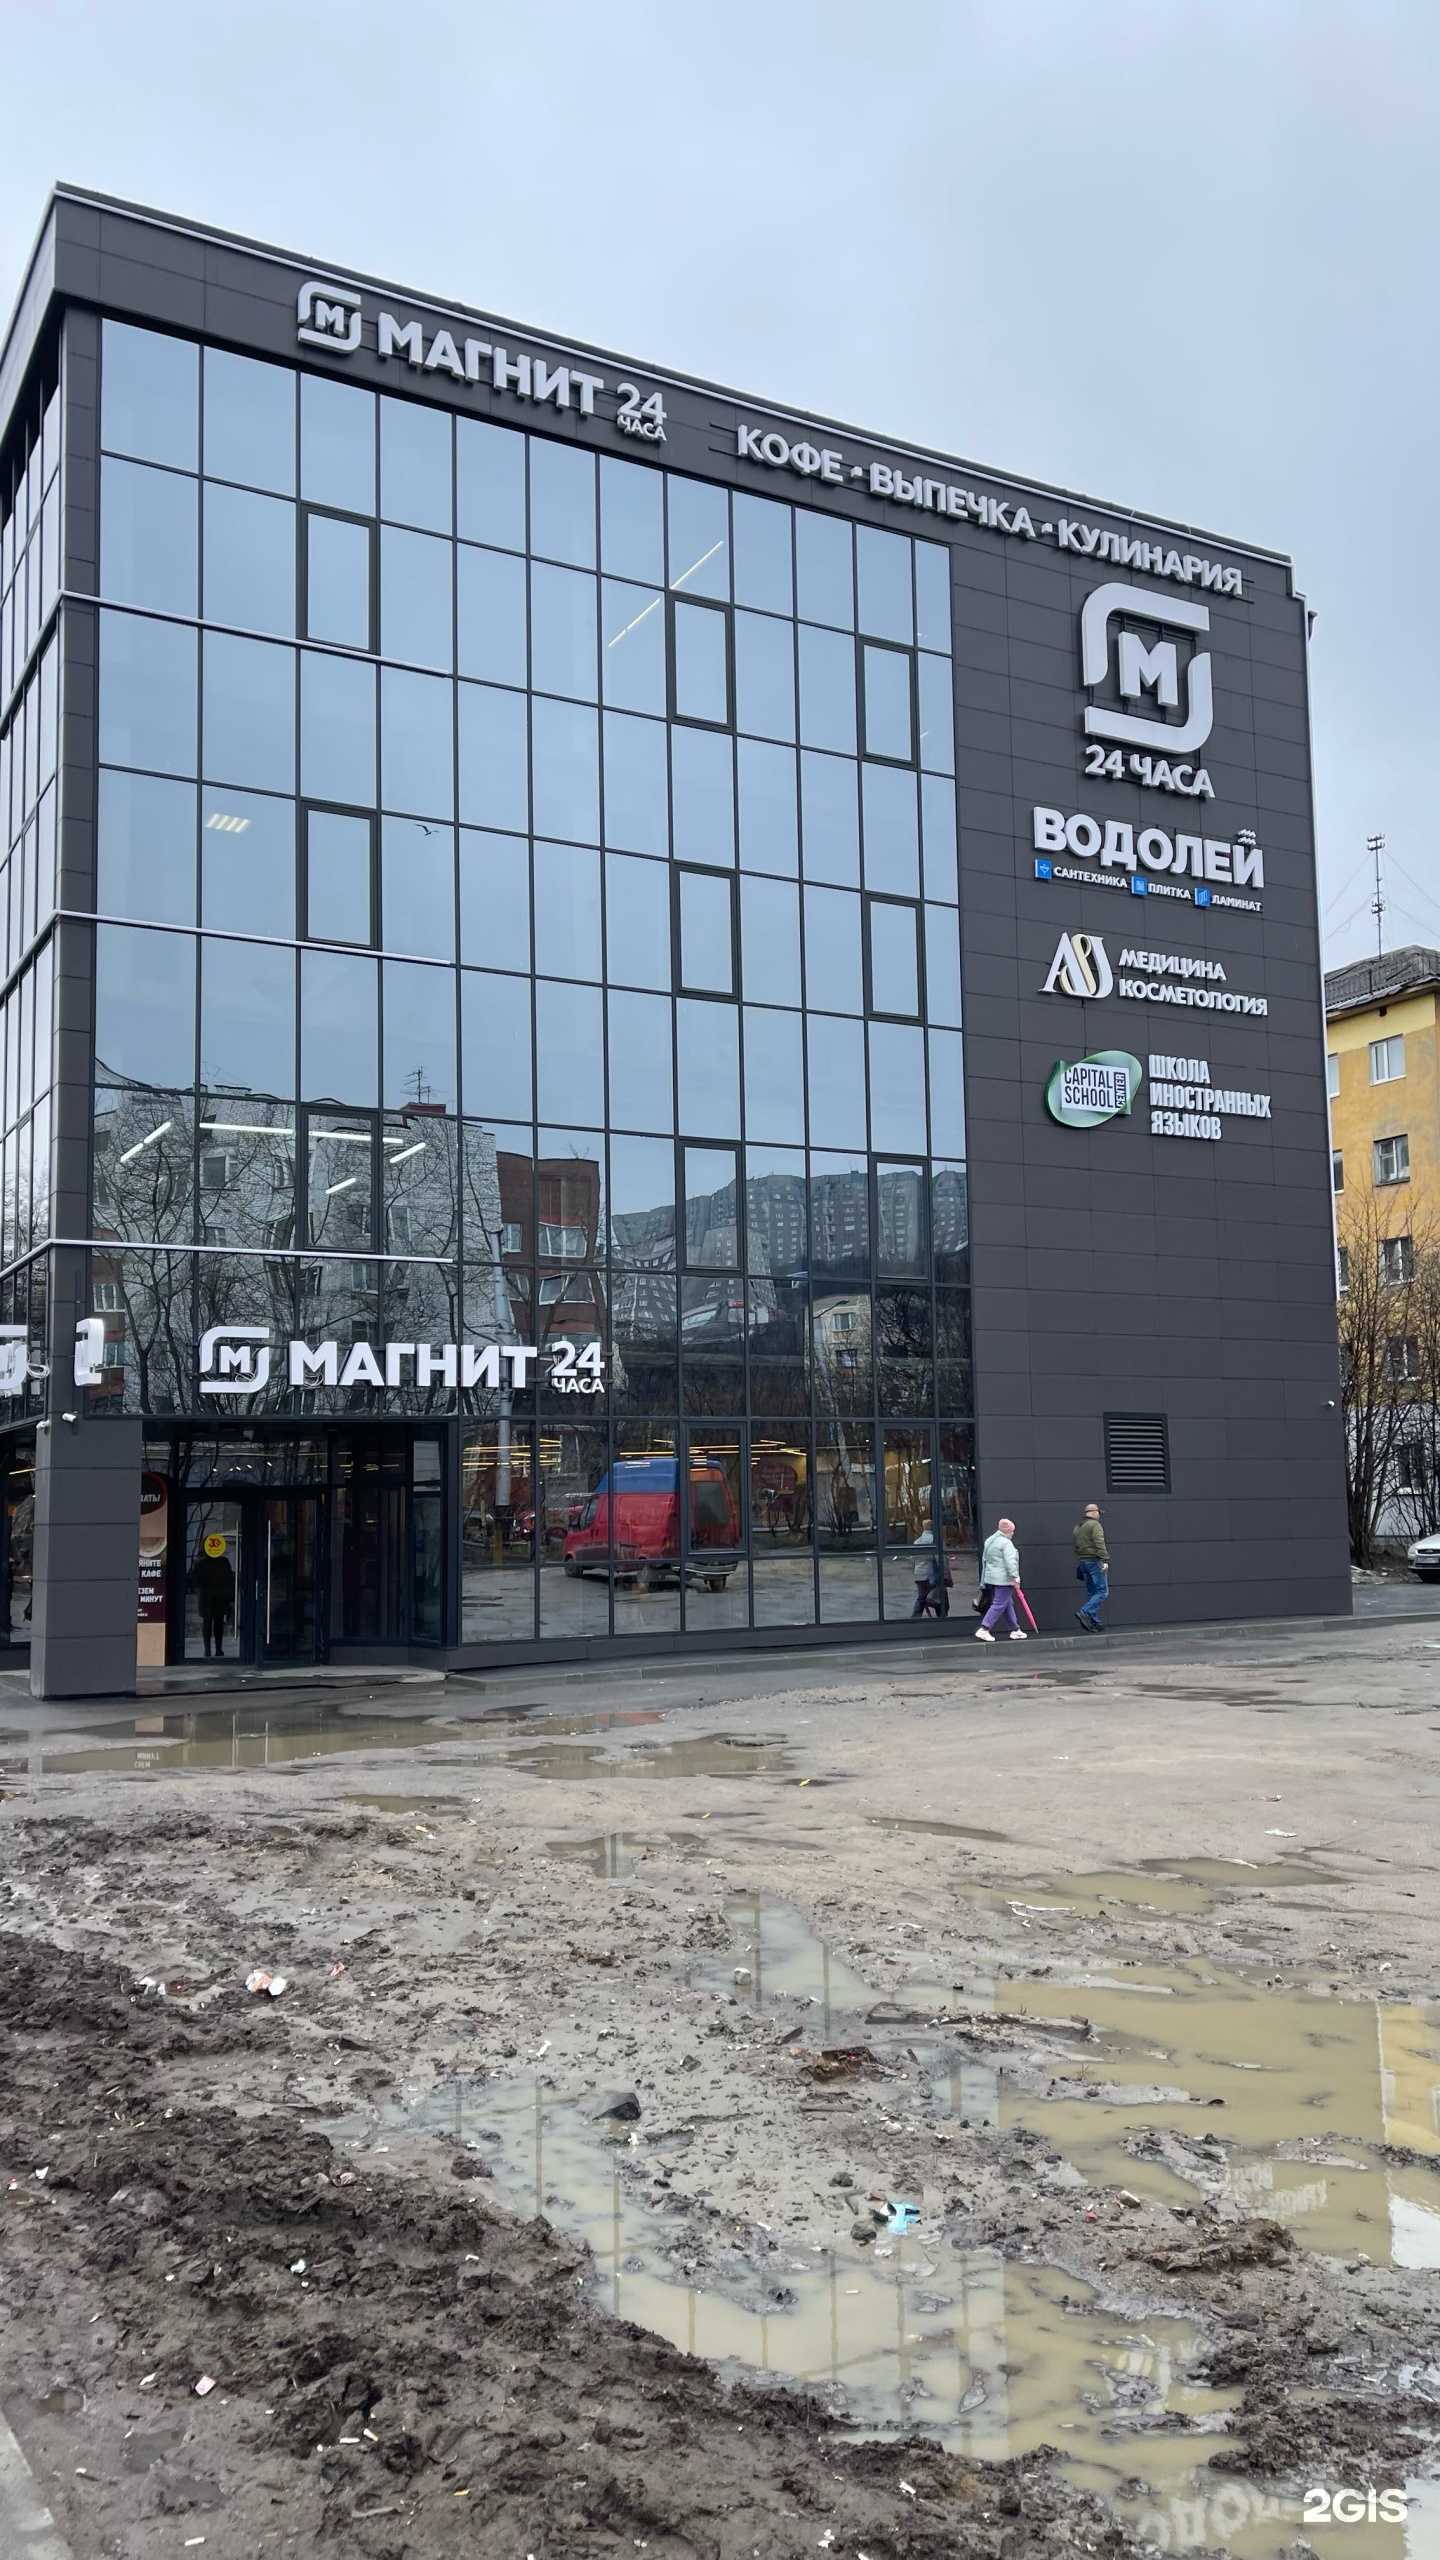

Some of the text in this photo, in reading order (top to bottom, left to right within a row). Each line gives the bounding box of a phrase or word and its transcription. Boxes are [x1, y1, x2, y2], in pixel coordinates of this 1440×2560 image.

[378, 312, 605, 416] МАГНИТ
[616, 383, 668, 425] 24
[616, 414, 668, 442] ЧАСА
[737, 424, 1244, 597] КОФЕ ВЫПЕЧКА КУЛИНАРИЯ
[1084, 745, 1216, 799] 24 ЧАСА
[1033, 806, 1265, 888] ВОДОЛЕЙ
[1053, 866, 1263, 913] САНТЕХНИКА ПЛИТКА ЛАМИНАТ
[1118, 949, 1227, 982] МЕДИЦИНА
[1118, 979, 1269, 1017] КОСМЕТОЛОГИЯ
[1064, 1067, 1113, 1089] CAPITAL
[1148, 1054, 1210, 1085] ШКОЛА
[1064, 1086, 1114, 1108] SCHOOL
[1115, 1072, 1126, 1108] CENTER
[1149, 1083, 1272, 1119] ИНОСТРАННЫХ
[1151, 1110, 1223, 1140] ЯЗЫКОВ
[288, 1340, 538, 1389] МАГНИТ
[551, 1341, 605, 1377] 24
[551, 1377, 606, 1395] ЧАСА
[140, 1493, 161, 1503] АТЫ
[138, 1559, 162, 1568] ЯНИТЕ
